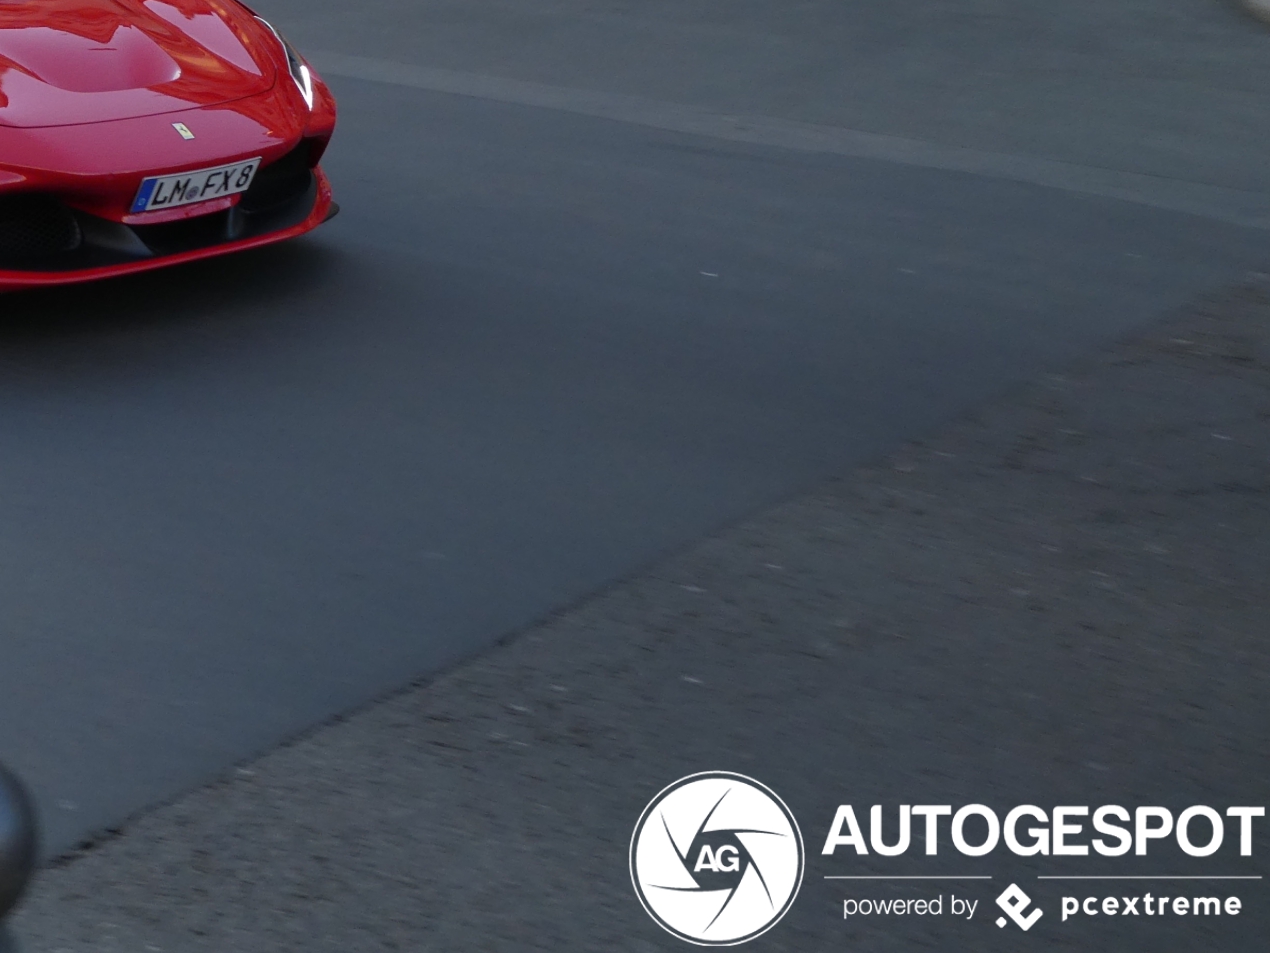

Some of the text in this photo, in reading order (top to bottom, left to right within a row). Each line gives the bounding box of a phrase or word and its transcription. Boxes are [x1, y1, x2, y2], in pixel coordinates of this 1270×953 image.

[151, 164, 253, 206] LM FX 8
